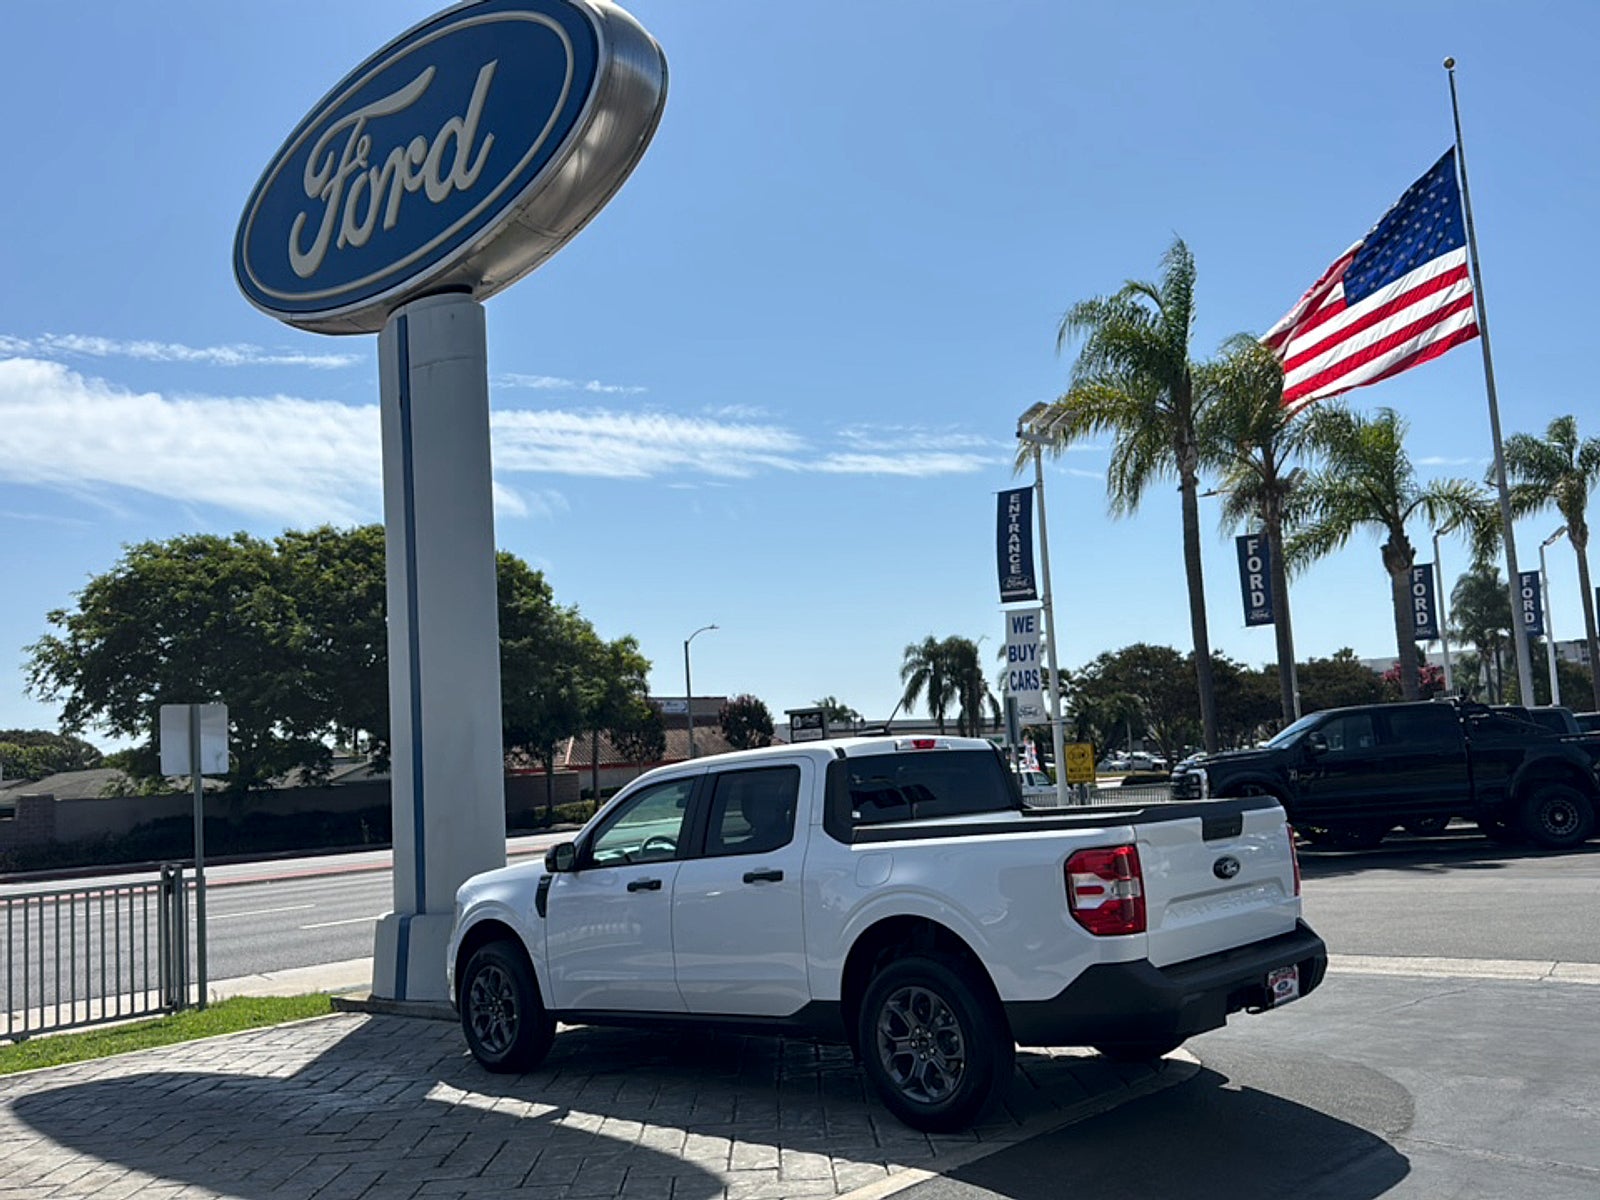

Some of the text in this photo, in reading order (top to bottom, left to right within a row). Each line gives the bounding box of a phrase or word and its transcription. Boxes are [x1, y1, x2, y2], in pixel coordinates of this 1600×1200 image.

[288, 58, 498, 278] Ford
[1008, 493, 1021, 575] ENTRANCE
[1247, 539, 1265, 608] FORD
[1413, 568, 1428, 625] FORD
[1521, 575, 1535, 623] FORD
[1012, 615, 1034, 634] WE
[1008, 643, 1037, 663] BUY
[1009, 670, 1039, 692] CARS
